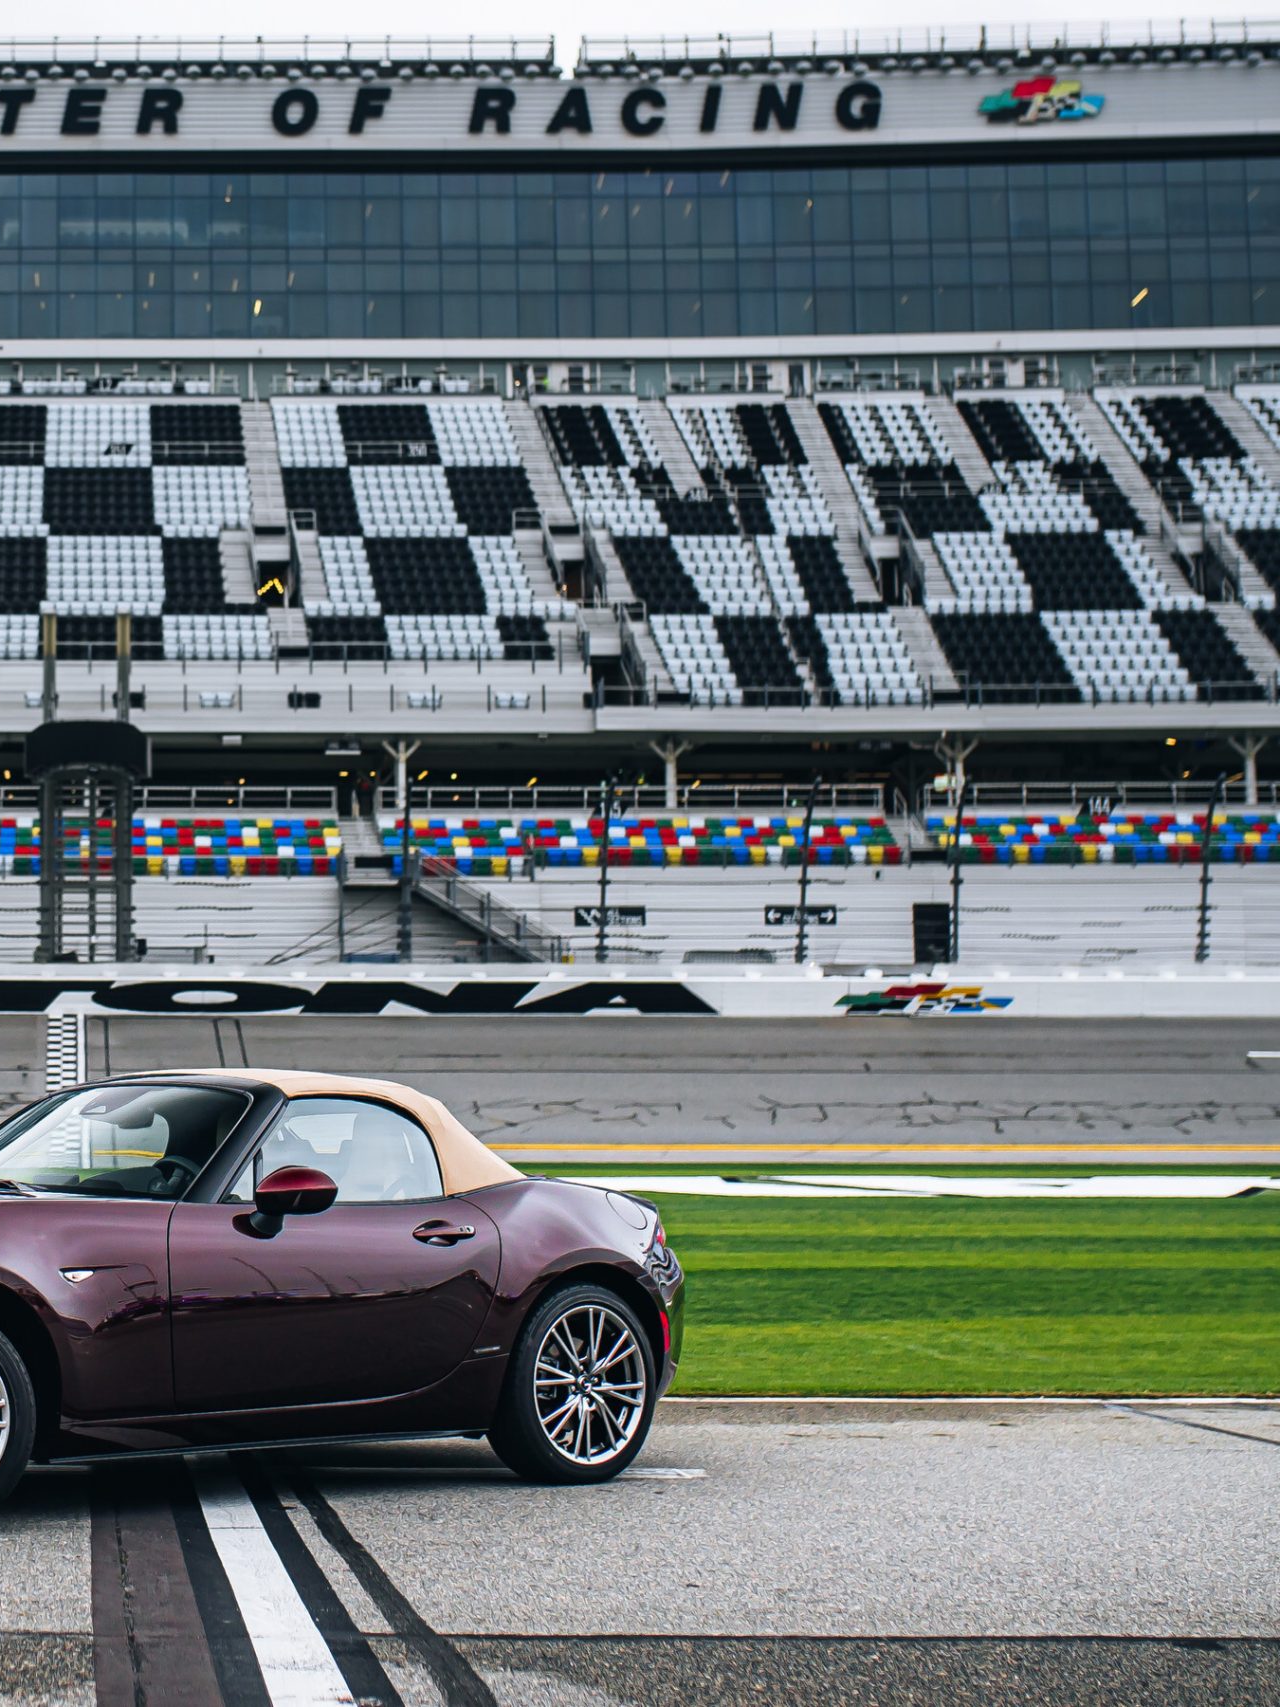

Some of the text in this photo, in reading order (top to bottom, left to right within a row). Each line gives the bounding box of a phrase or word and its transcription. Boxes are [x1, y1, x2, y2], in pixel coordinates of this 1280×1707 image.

[271, 86, 391, 137] OF
[468, 82, 883, 137] RACING
[600, 801, 622, 818] 15
